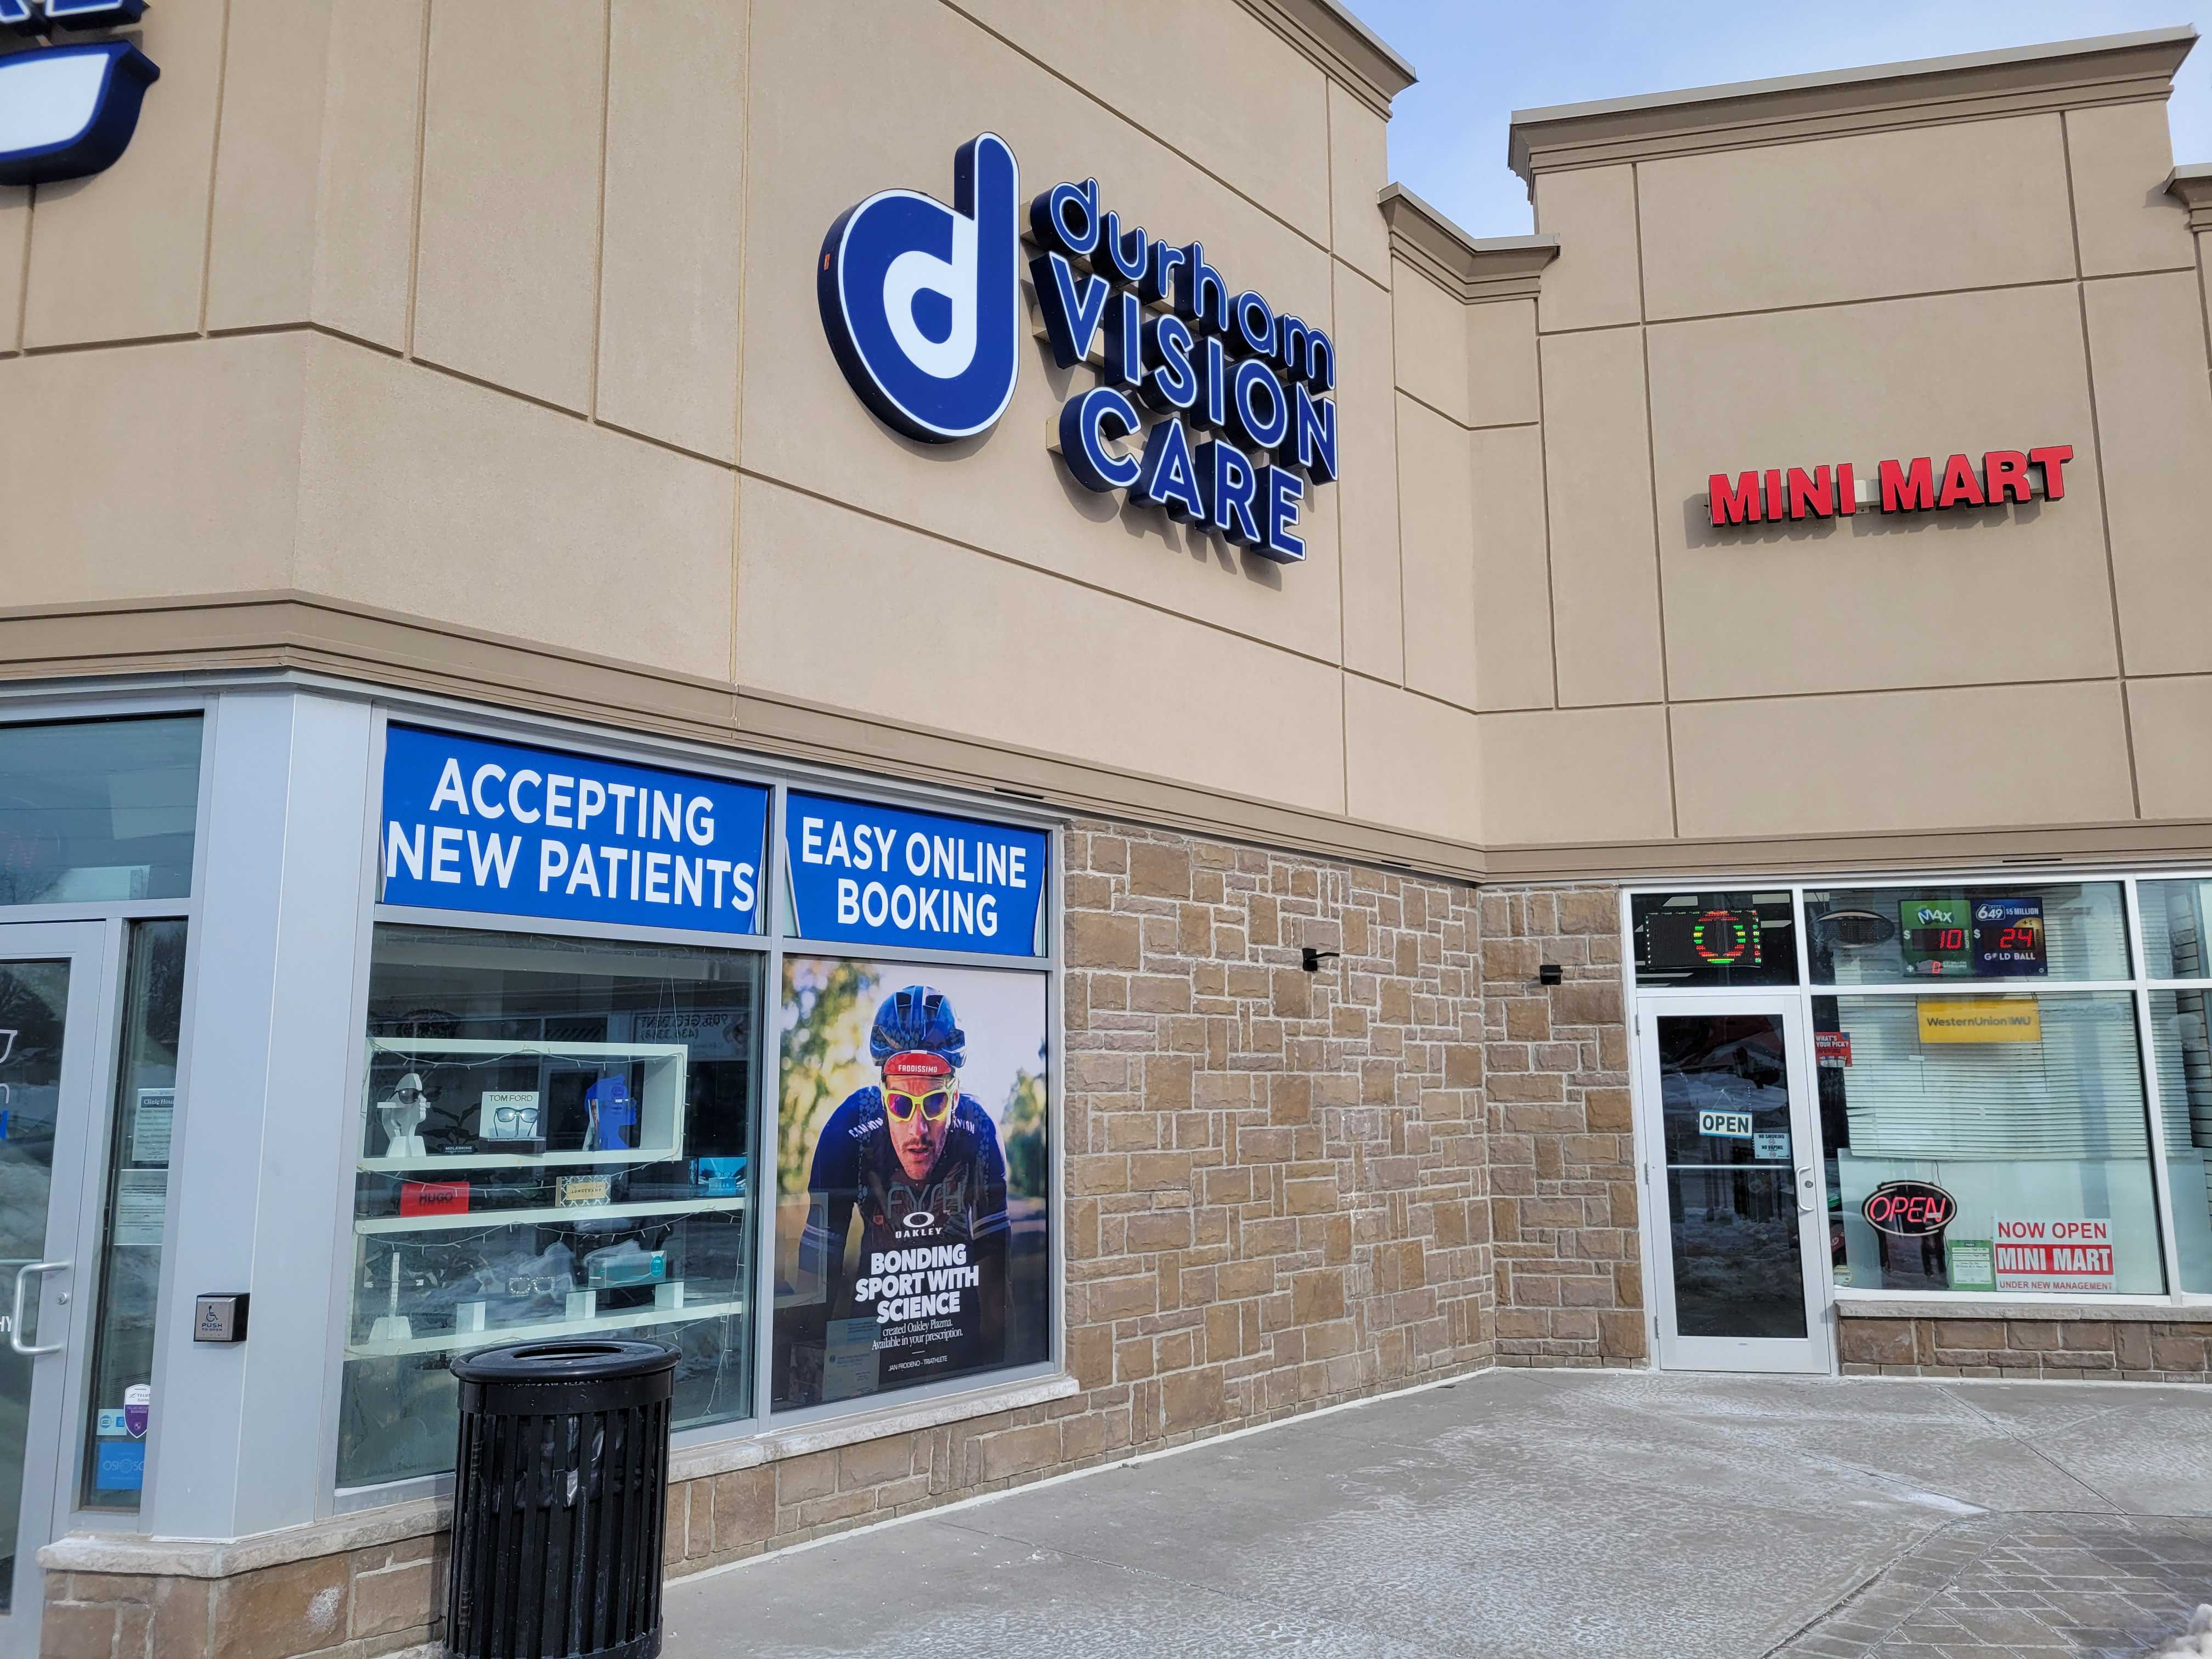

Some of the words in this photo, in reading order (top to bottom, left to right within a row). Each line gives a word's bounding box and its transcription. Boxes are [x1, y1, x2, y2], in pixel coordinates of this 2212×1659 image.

[1050, 177, 1334, 390] durham
[1049, 252, 1338, 481] VISION
[1080, 386, 1306, 560] CARE
[1709, 462, 1856, 526] MINI
[1879, 445, 2073, 512] MART
[430, 758, 714, 846] ACCEPTING
[802, 816, 897, 872] EASY
[906, 832, 1026, 888] ONLINE
[387, 821, 522, 888] NEW
[539, 839, 755, 912] PATIENTS
[838, 878, 997, 936] BOOKING
[1917, 909, 1953, 924] MAX
[1940, 929, 1962, 949] 10
[2000, 928, 2033, 949] 24
[898, 1064, 938, 1073] FRODISSIMO
[1702, 1114, 1749, 1133] OPEN
[419, 1192, 453, 1203] HUGO
[1869, 1196, 1946, 1223] OPEN
[895, 1227, 941, 1239] OAKLEY
[1997, 1222, 2045, 1238] NOW
[2052, 1222, 2107, 1239] OPEN
[871, 1243, 967, 1276] BONDING
[1997, 1247, 2047, 1271] MINI
[2052, 1248, 2111, 1272] MART
[855, 1272, 925, 1302] SPORT
[927, 1265, 979, 1292] WITH
[2052, 1282, 2112, 1290] MANAGEMENT
[876, 1291, 961, 1324] SCIENCE
[871, 1335, 901, 1351] Available
[901, 1335, 909, 1345] in
[909, 1334, 926, 1347] your
[924, 1328, 963, 1345] prescription.
[883, 1324, 906, 1336] created
[907, 1321, 930, 1333] Oakley
[930, 1318, 953, 1329] Plazma.
[898, 1361, 921, 1370] FRODENO
